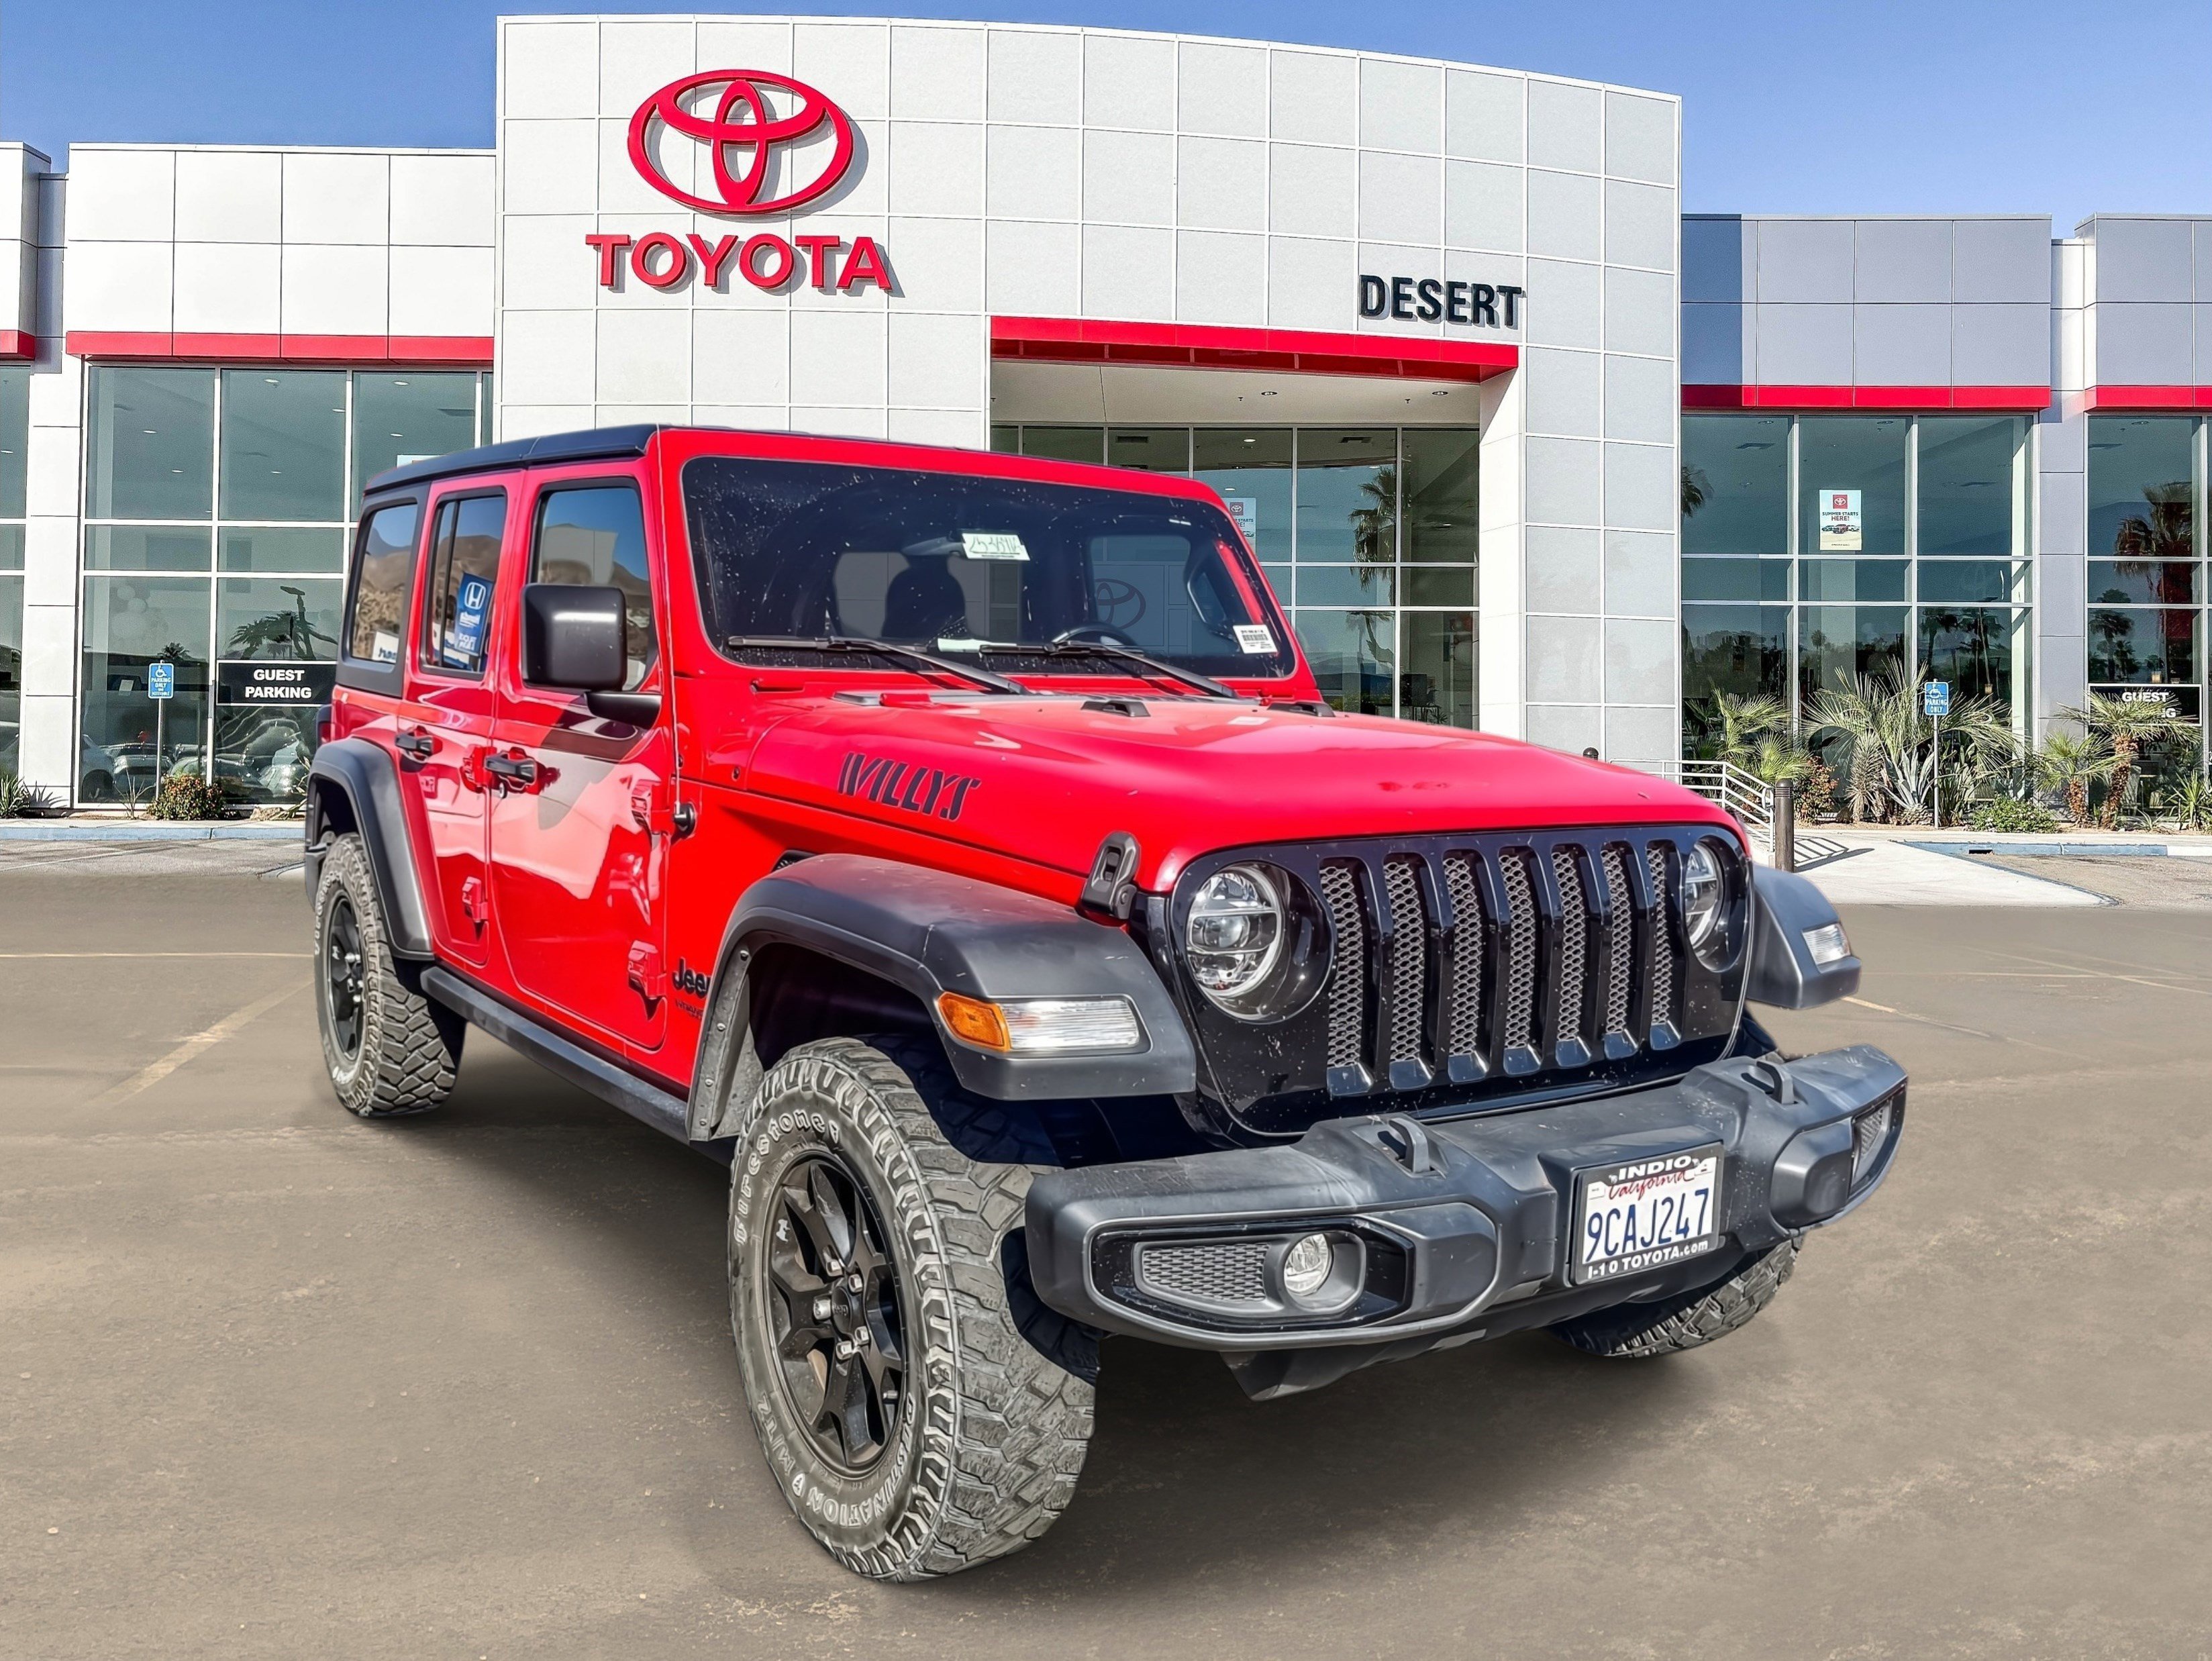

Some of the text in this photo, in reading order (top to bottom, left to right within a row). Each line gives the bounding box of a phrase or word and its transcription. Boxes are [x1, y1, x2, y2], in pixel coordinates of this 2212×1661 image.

[585, 232, 893, 290] TOYOTA
[1358, 274, 1523, 327] DESERT
[253, 668, 305, 682] GUEST
[244, 685, 312, 699] PARKING
[2121, 691, 2169, 703] GUEST
[838, 751, 982, 821] WILLYS
[1618, 1155, 1692, 1181] INDIO
[1609, 1169, 1695, 1201] California
[1585, 1187, 1709, 1263] 9CAJ247
[1621, 1240, 1709, 1270] TOYOTA.com
